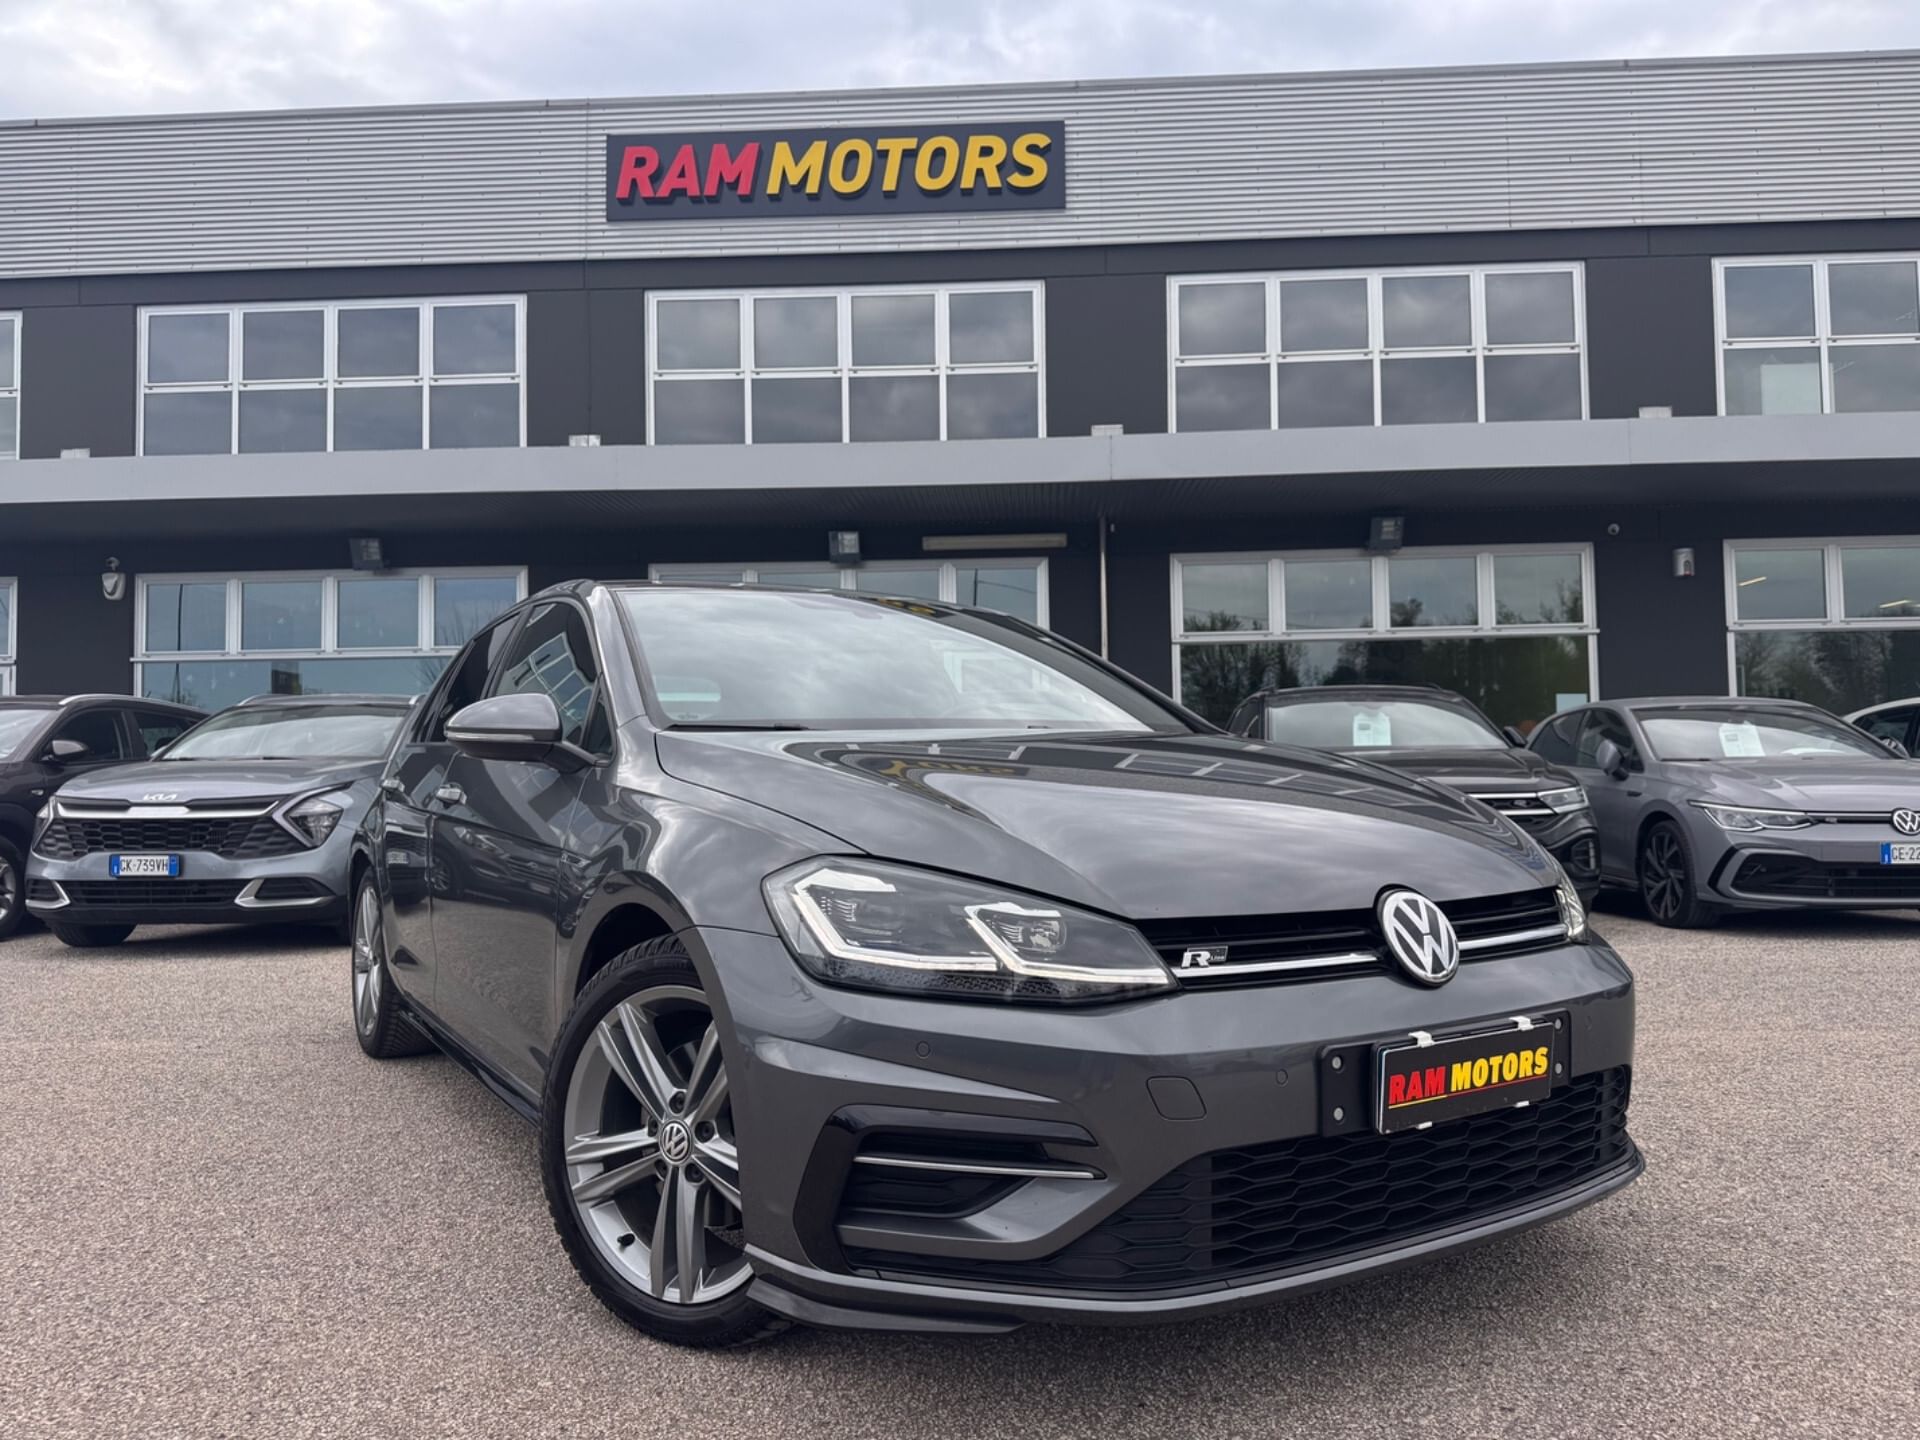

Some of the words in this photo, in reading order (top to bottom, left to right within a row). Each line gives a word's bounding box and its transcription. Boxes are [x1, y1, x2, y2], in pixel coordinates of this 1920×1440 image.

[616, 142, 760, 199] RAM
[767, 132, 1052, 195] MOTORS
[1181, 951, 1210, 968] R
[1383, 891, 1457, 977] VW
[1388, 1066, 1446, 1105] RAM
[1451, 1046, 1549, 1092] MOTORS
